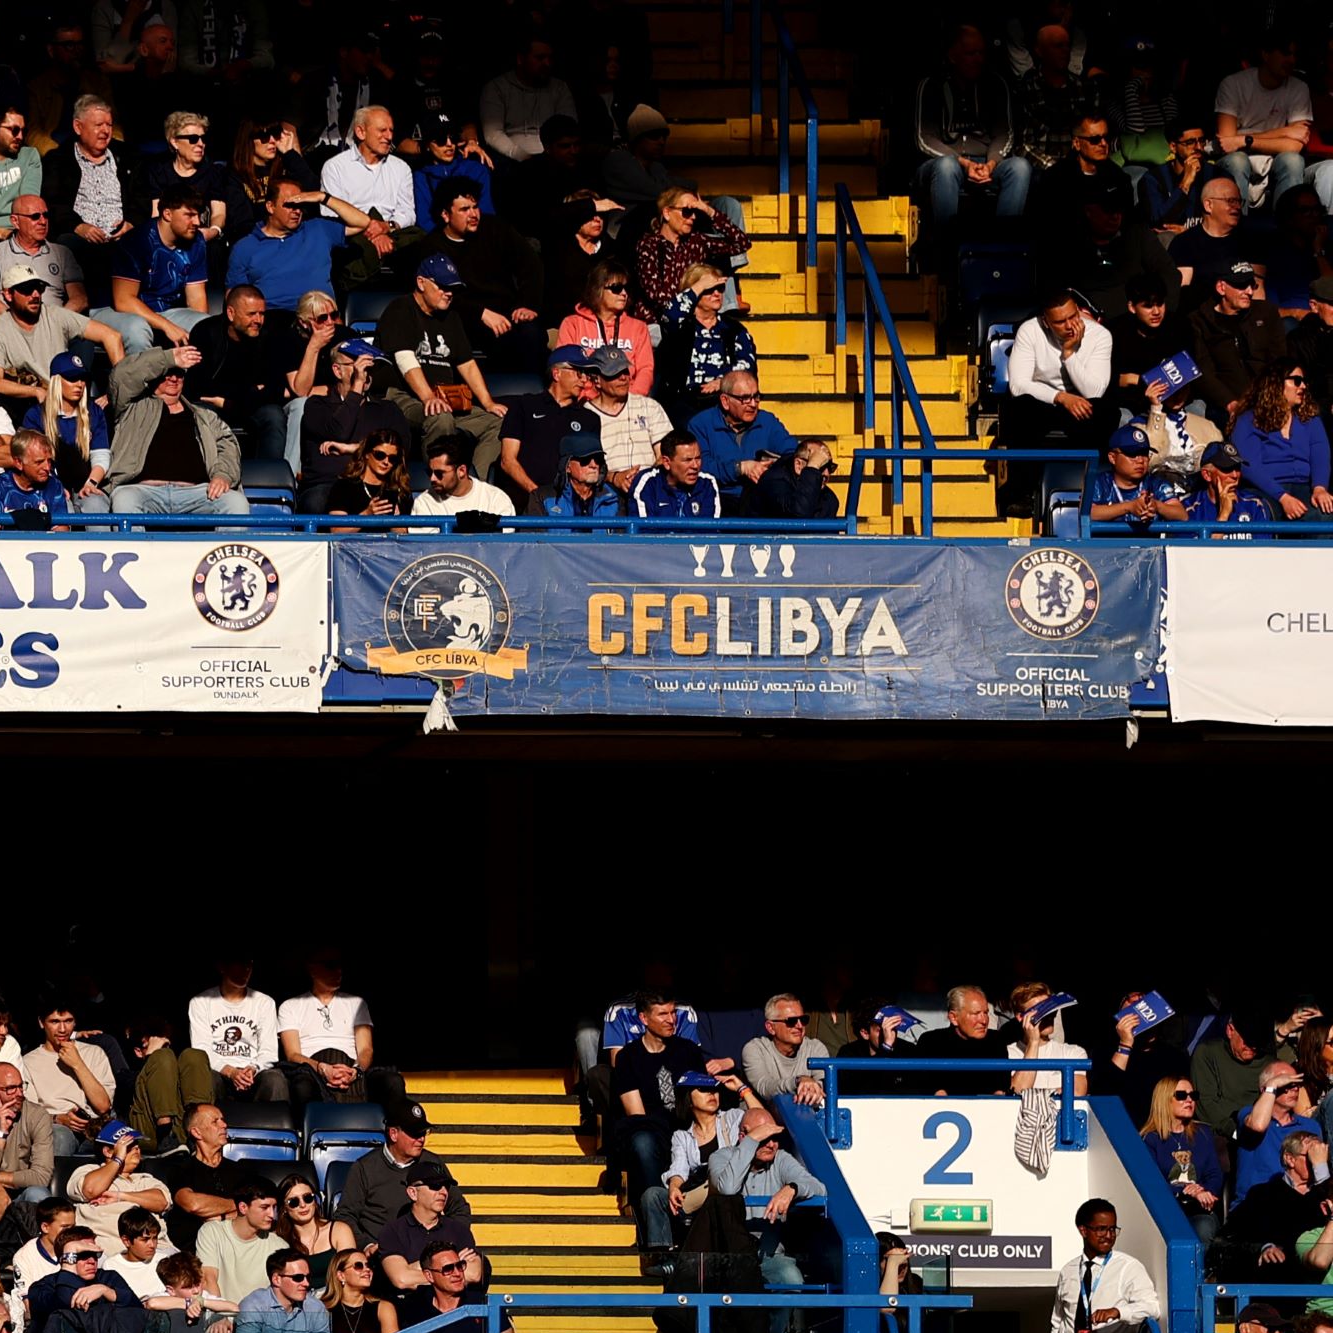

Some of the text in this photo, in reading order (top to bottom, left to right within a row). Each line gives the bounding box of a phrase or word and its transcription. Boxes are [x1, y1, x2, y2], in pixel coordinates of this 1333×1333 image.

[206, 546, 264, 566] CHELSEA
[1021, 552, 1082, 574] CHELSEA
[205, 610, 267, 630] FOOTBALL CLUB
[1021, 617, 1085, 637] FOOTBALL CLUB
[1267, 612, 1333, 633] CHEL
[199, 660, 272, 673] OFFICIAL
[415, 654, 478, 667] CFC LIBYA
[1015, 667, 1091, 681] OFFICIAL
[161, 676, 310, 689] SUPPORTERS CLUB
[818, 679, 857, 695] رابطة
[213, 690, 260, 700] DUNDALK
[976, 683, 1130, 700] SUPPORTERS CLUB
[922, 1110, 974, 1186] 2
[958, 1244, 1000, 1258] CLUB
[1003, 1244, 1044, 1259] ONLY
